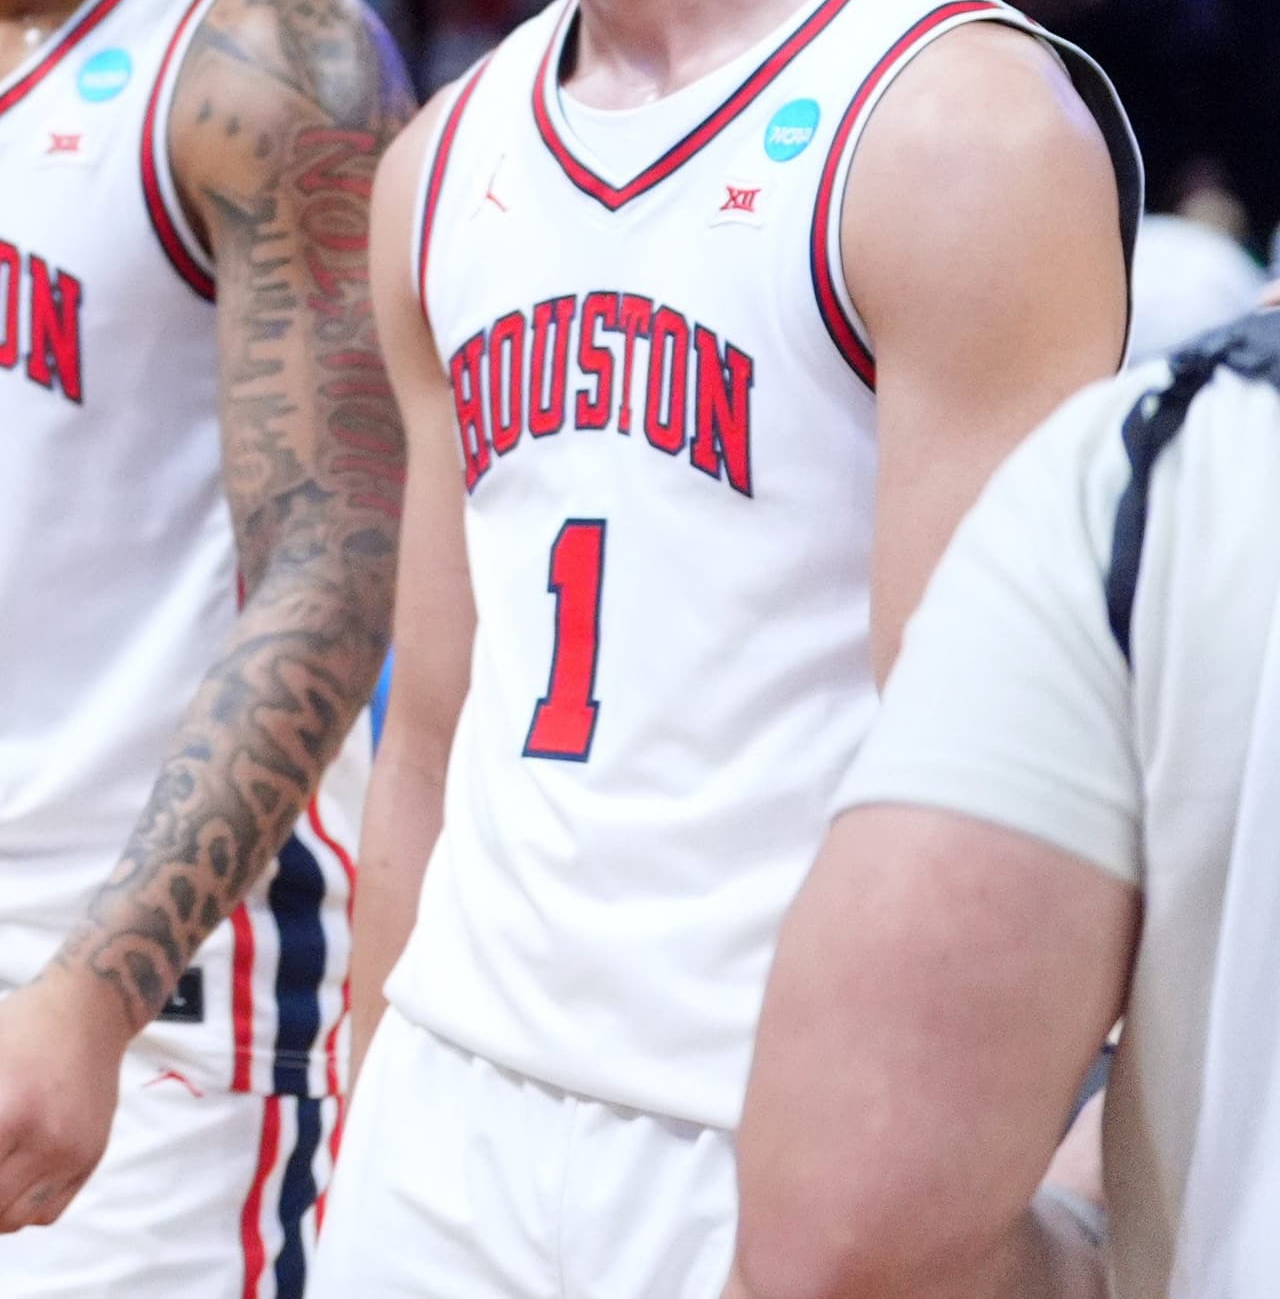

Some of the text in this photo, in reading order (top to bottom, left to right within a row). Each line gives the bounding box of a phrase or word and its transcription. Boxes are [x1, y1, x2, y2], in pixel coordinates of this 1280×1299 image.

[720, 185, 762, 212] XII
[448, 291, 754, 499] HOUSTON
[521, 518, 608, 763] 1
